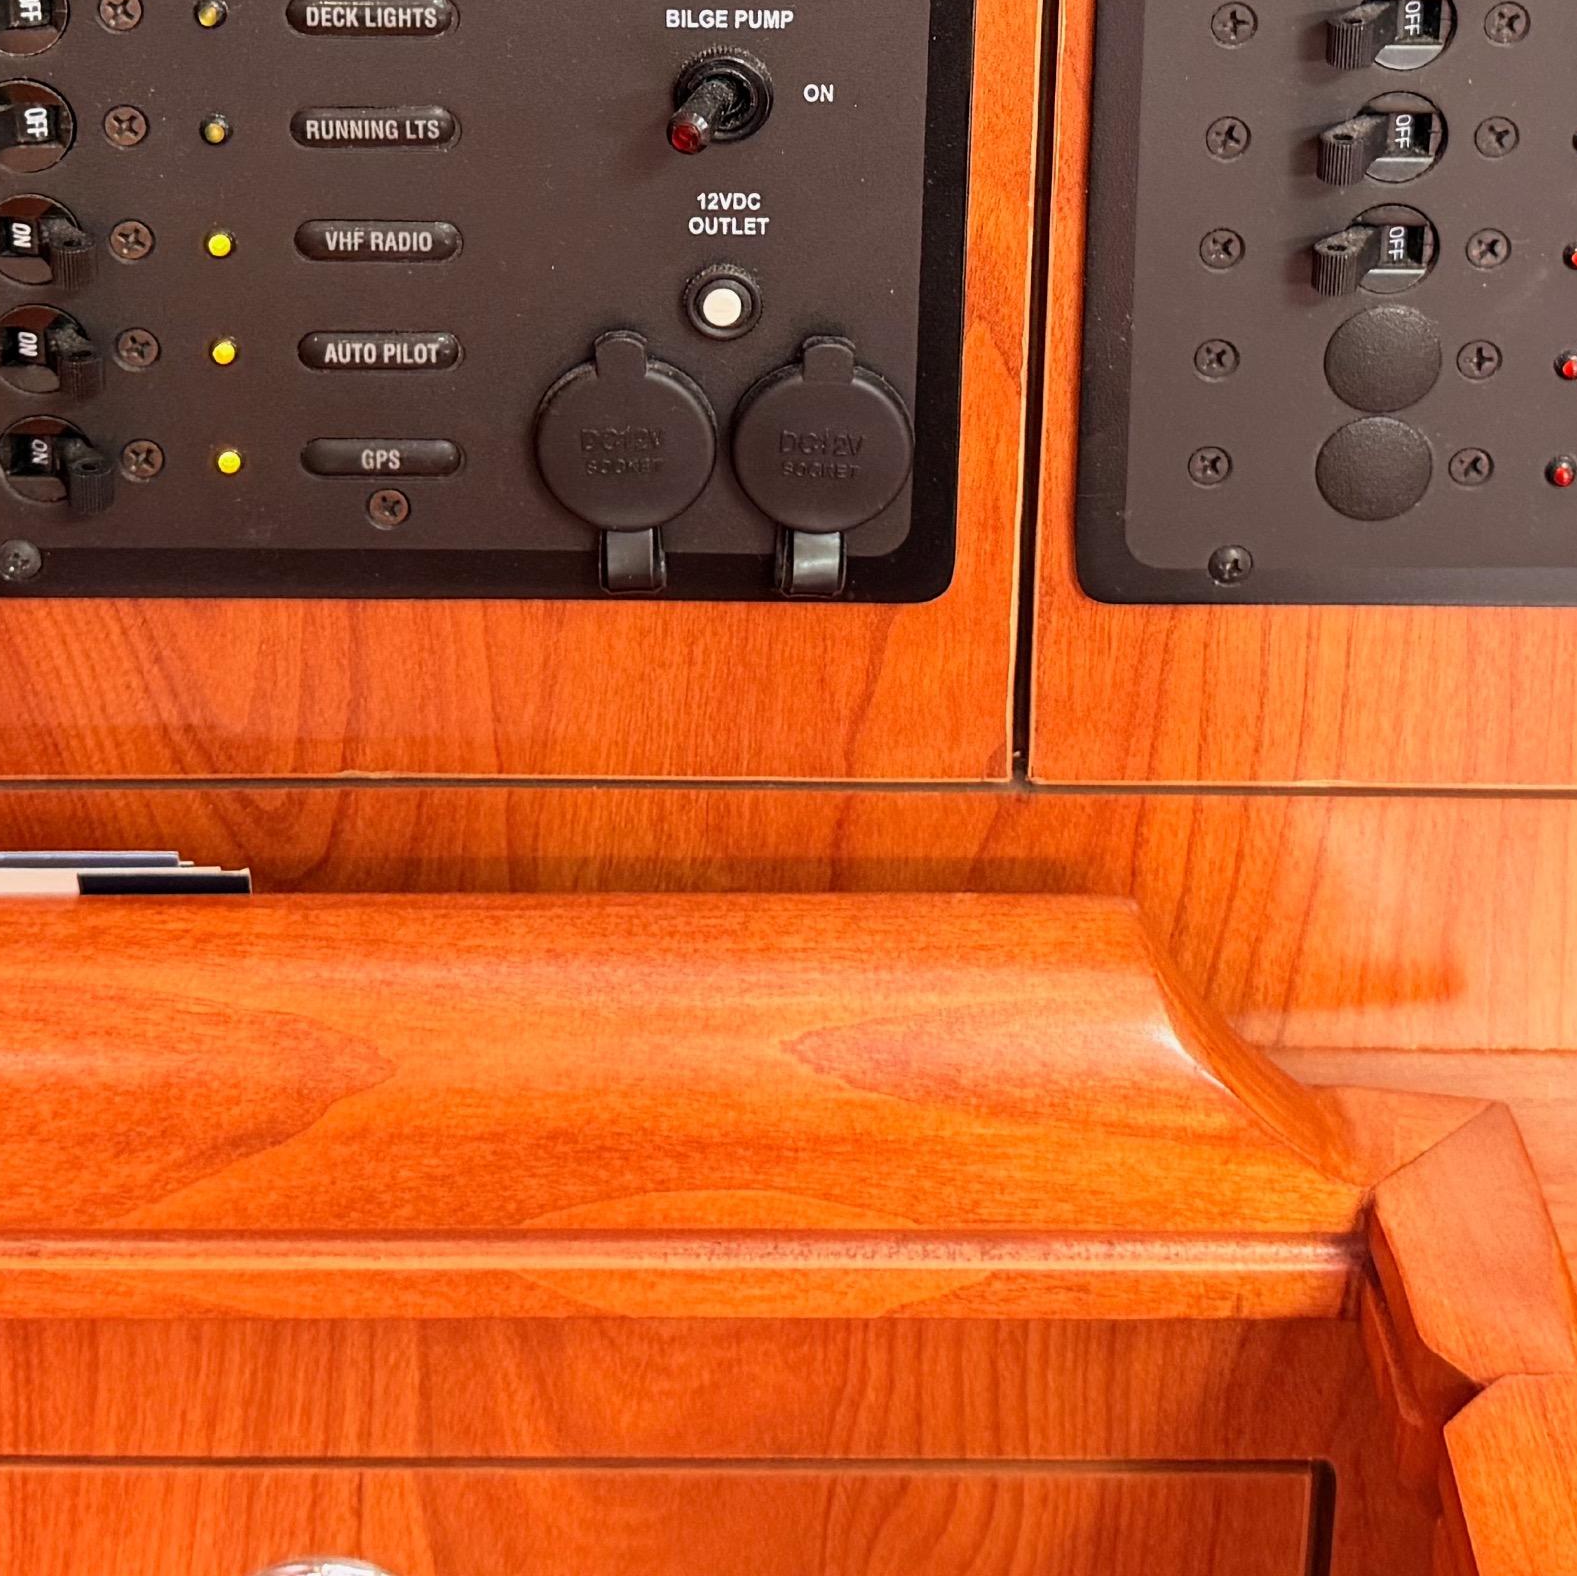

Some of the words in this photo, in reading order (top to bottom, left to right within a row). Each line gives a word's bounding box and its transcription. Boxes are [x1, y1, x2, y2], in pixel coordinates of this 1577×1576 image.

[305, 6, 360, 28] DECK
[364, 7, 438, 29] LIGHTS
[666, 9, 728, 29] BILGE
[734, 10, 794, 29] PUMP
[1405, 0, 1421, 35] OFF
[803, 84, 835, 103] ON
[24, 107, 49, 140] OFF
[305, 119, 398, 140] RUNNING
[403, 119, 440, 141] LTS
[1395, 114, 1412, 149] OFF
[697, 193, 761, 211] 12VDC
[11, 222, 33, 249] ON
[688, 217, 770, 236] OUTLET
[324, 231, 365, 252] VHF
[369, 231, 433, 253] RADIO
[1389, 226, 1405, 261] OFF
[18, 332, 39, 357] ON
[324, 343, 379, 364] AUTO
[383, 343, 439, 365] PILOT
[31, 439, 48, 465] ON
[360, 450, 400, 470] GPS
